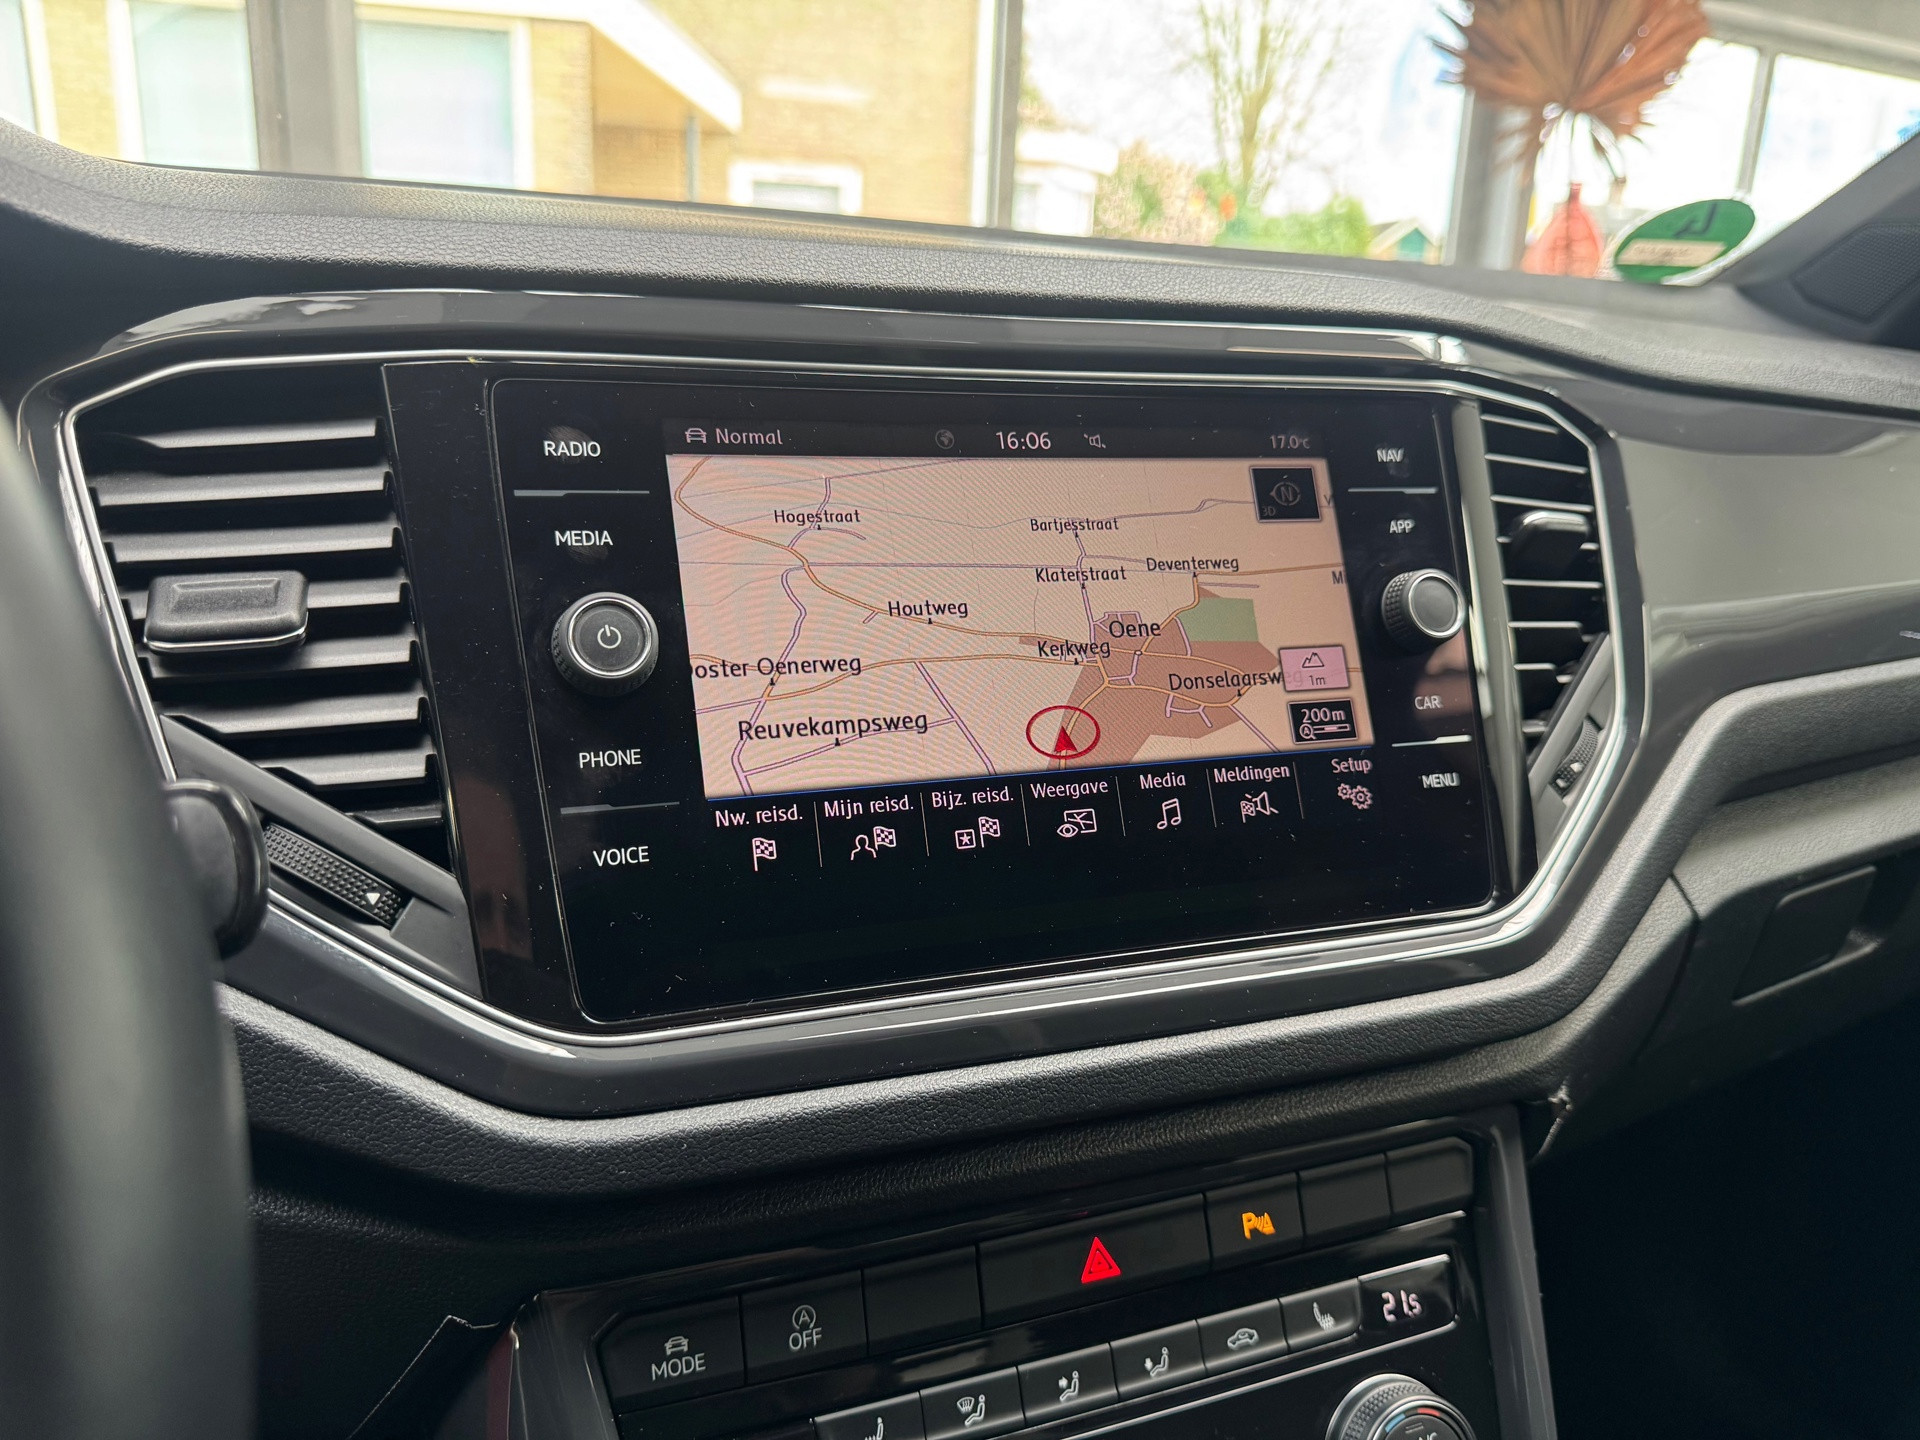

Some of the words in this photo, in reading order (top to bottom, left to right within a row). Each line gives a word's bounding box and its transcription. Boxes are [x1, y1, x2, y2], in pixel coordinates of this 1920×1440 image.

[715, 428, 783, 446] Normal
[995, 431, 1052, 450] 16:06
[543, 440, 601, 458] RADIO
[1376, 448, 1404, 463] NAV
[774, 508, 861, 527] Hogestraat
[1030, 516, 1119, 535] Bartjesstraat
[1389, 519, 1416, 534] APP
[554, 529, 613, 547] MEDIA
[1035, 566, 1127, 583] Klaterstraat
[1146, 556, 1240, 574] Deventerweg
[888, 600, 969, 619] Houtweg
[1109, 620, 1162, 638] Oene
[1037, 640, 1111, 659] Kerkweg
[690, 659, 749, 678] oster
[757, 656, 862, 676] Oenerweg
[1308, 674, 1327, 687] 1m
[1414, 695, 1443, 710] CAR
[738, 713, 928, 742] Reuvekampsweg
[579, 748, 642, 769] PHONE
[1331, 756, 1372, 775] Setup
[1140, 771, 1186, 791] Media
[1214, 765, 1290, 784] Meldingen
[1421, 772, 1460, 788] MENU
[931, 791, 968, 811] Bijz.
[972, 785, 1014, 806] reisd.
[1030, 779, 1109, 800] Weergave
[715, 810, 750, 829] Nw.
[756, 804, 803, 825] reisd.
[823, 799, 863, 820] Mijn
[869, 794, 915, 814] reisd.
[593, 845, 650, 868] VOICE
[788, 1326, 822, 1351] OFF
[651, 1352, 707, 1381] MODE
